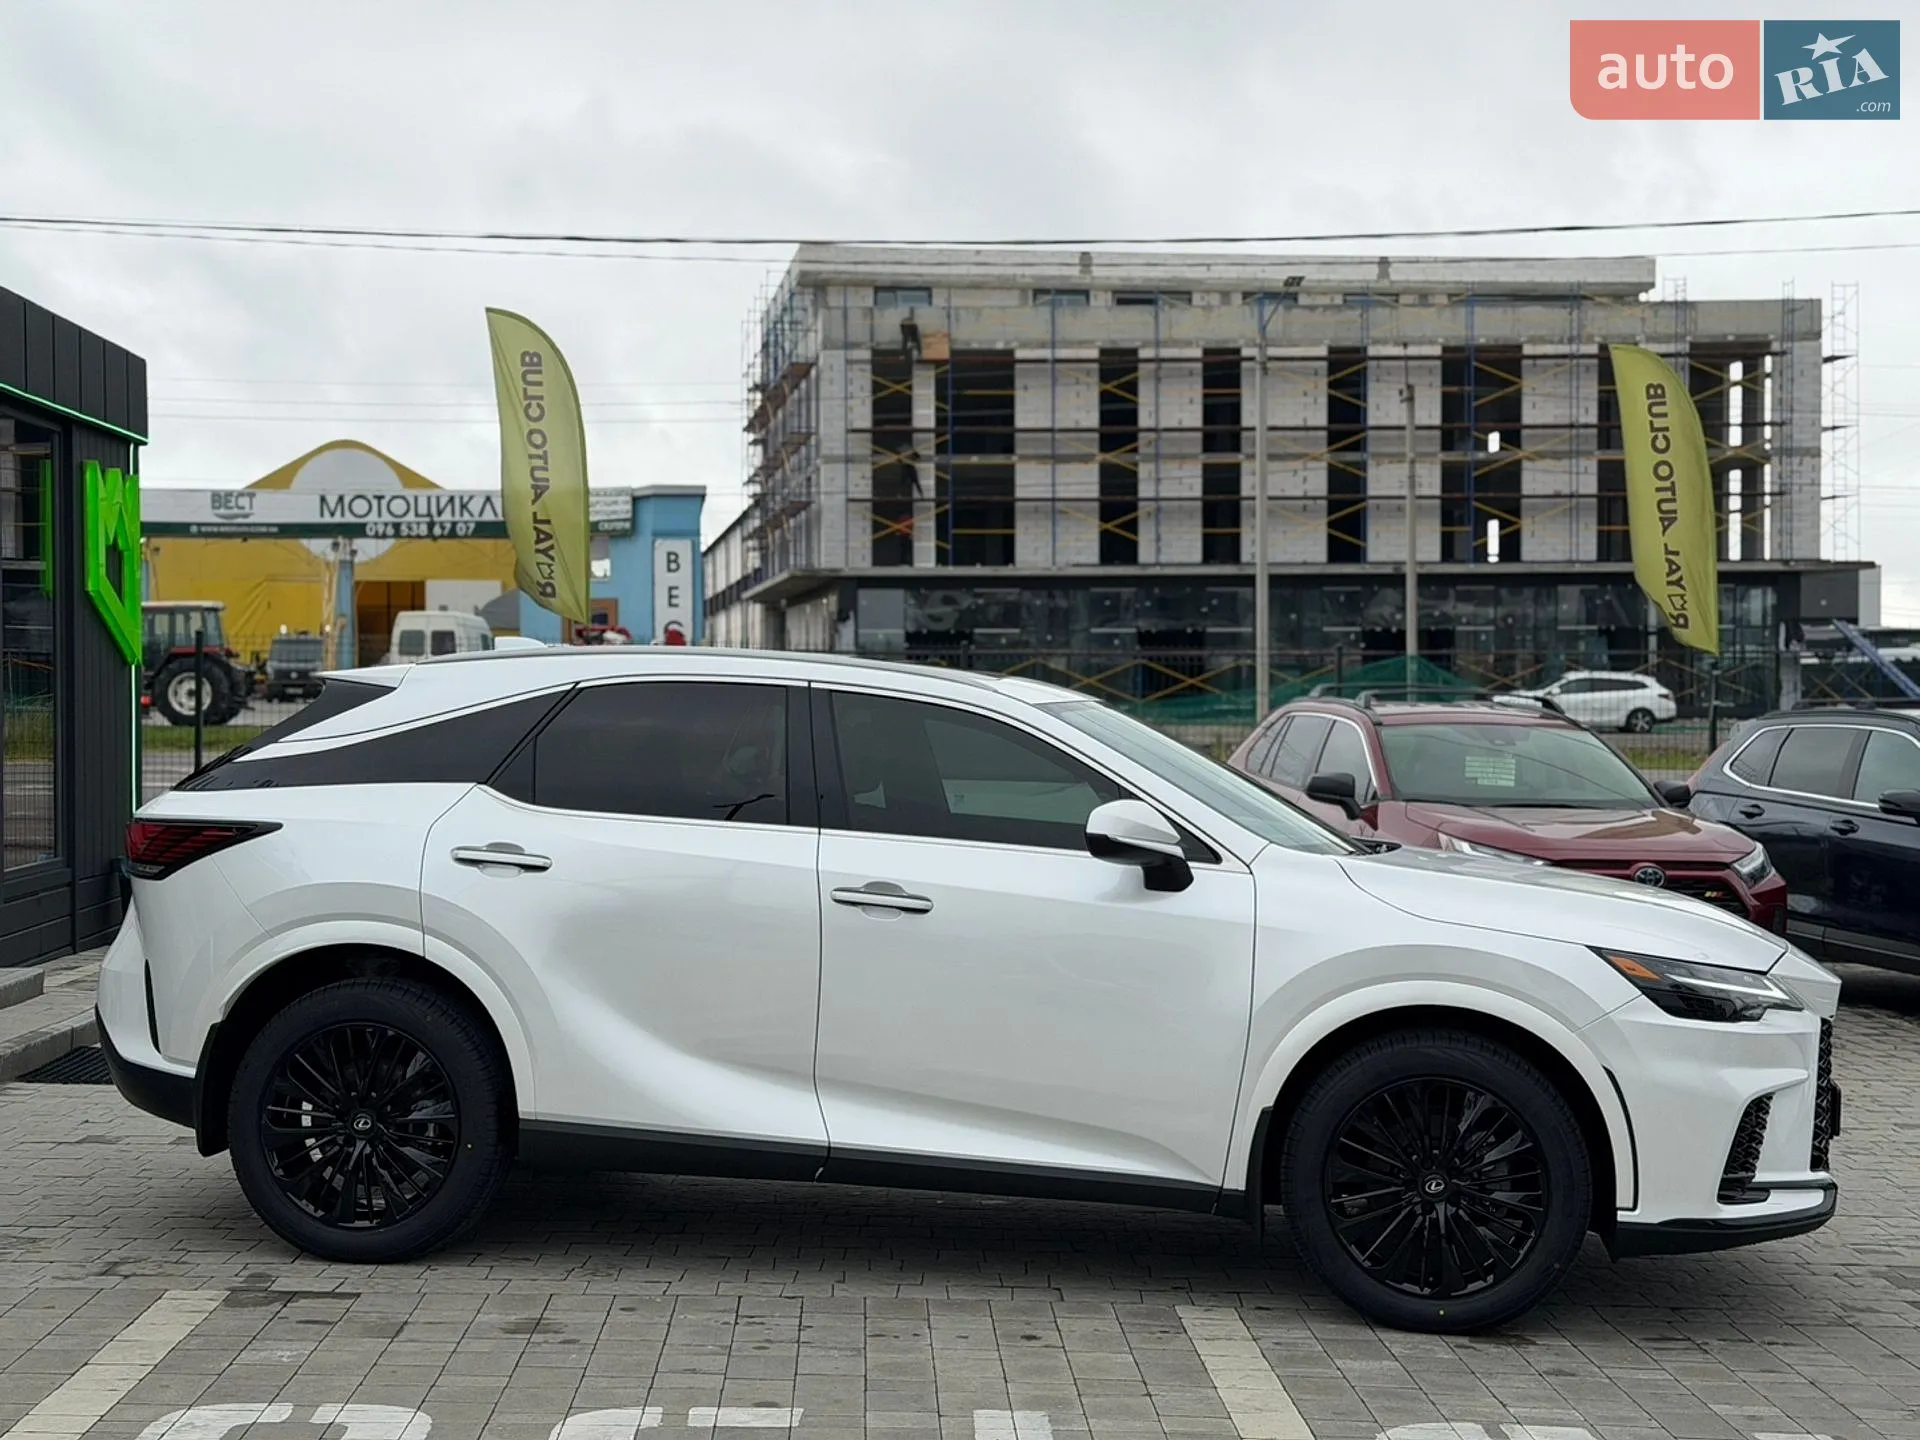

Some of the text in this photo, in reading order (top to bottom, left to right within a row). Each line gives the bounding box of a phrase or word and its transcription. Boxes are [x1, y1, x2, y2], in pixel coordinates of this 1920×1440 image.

[210, 492, 256, 510] ВЕСТ
[365, 523, 476, 537] 096 538 67 07
